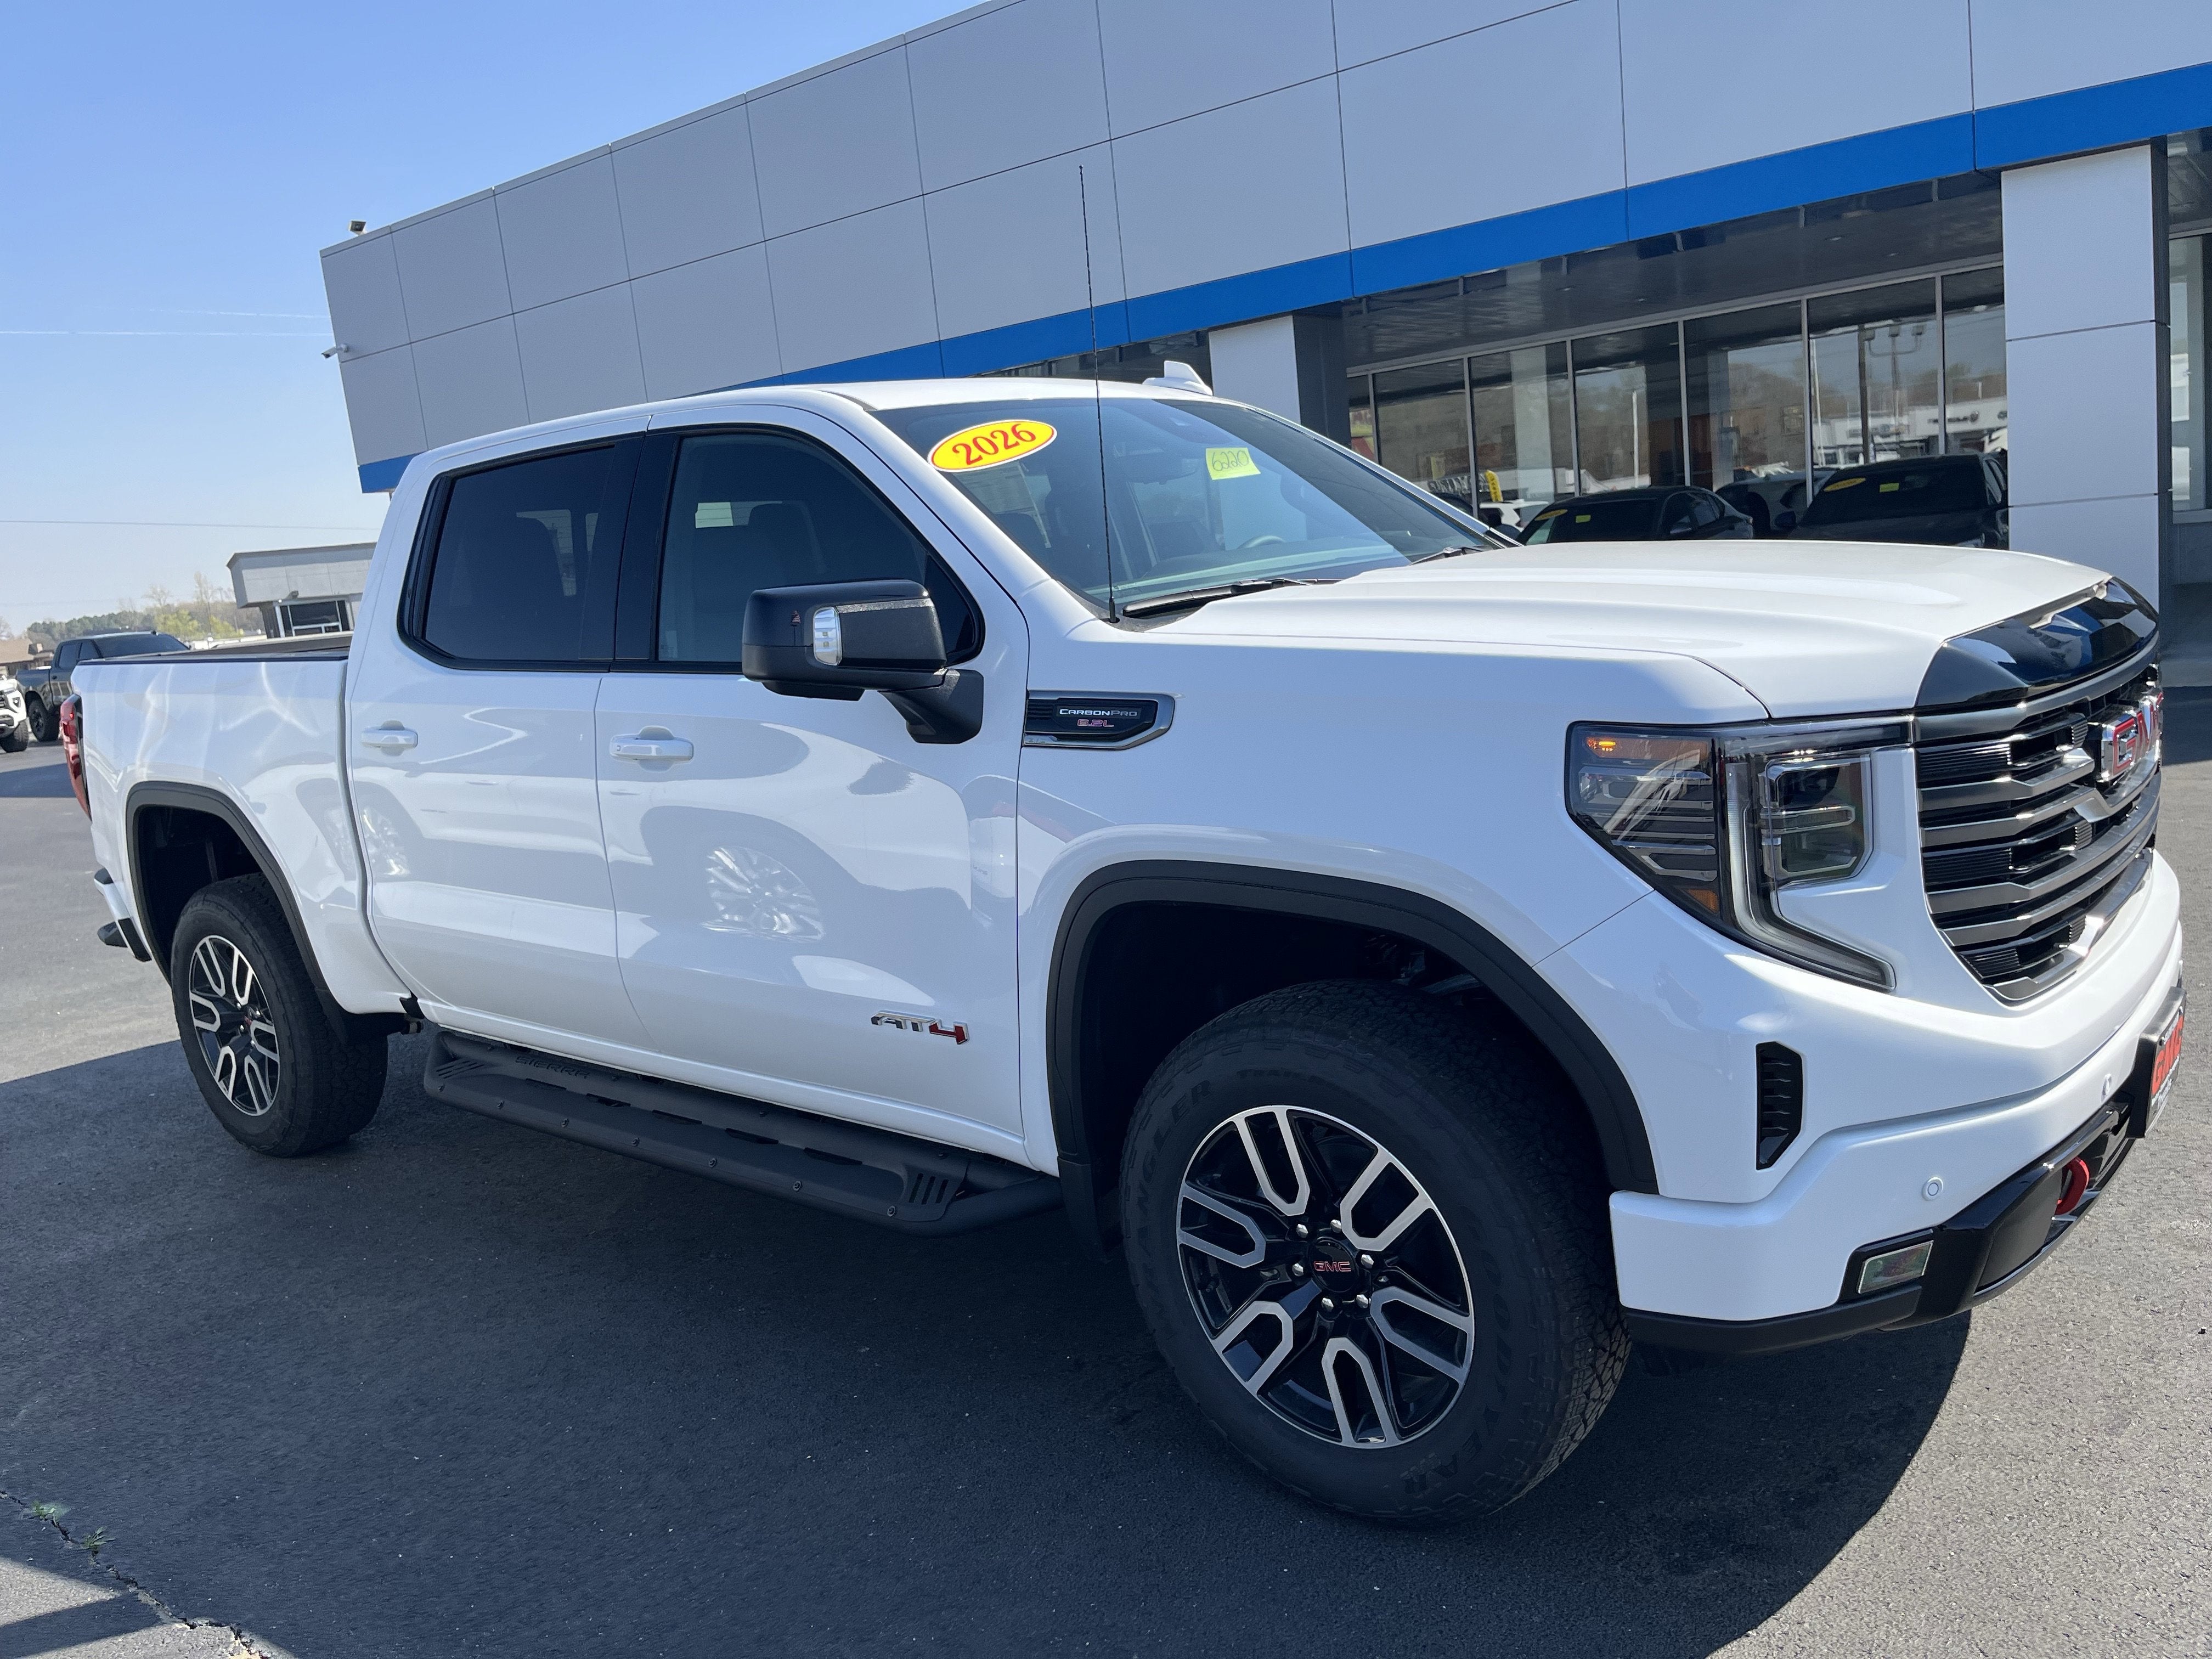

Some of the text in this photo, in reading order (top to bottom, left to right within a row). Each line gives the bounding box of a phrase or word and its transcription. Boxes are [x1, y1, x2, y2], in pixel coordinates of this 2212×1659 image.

[952, 424, 1036, 465] 2026
[1211, 450, 1250, 472] 6220
[1076, 718, 1115, 728] 6.2L
[871, 1009, 970, 1045] AT4
[515, 1056, 591, 1079] SIERRA
[1313, 1261, 1352, 1272] GMC
